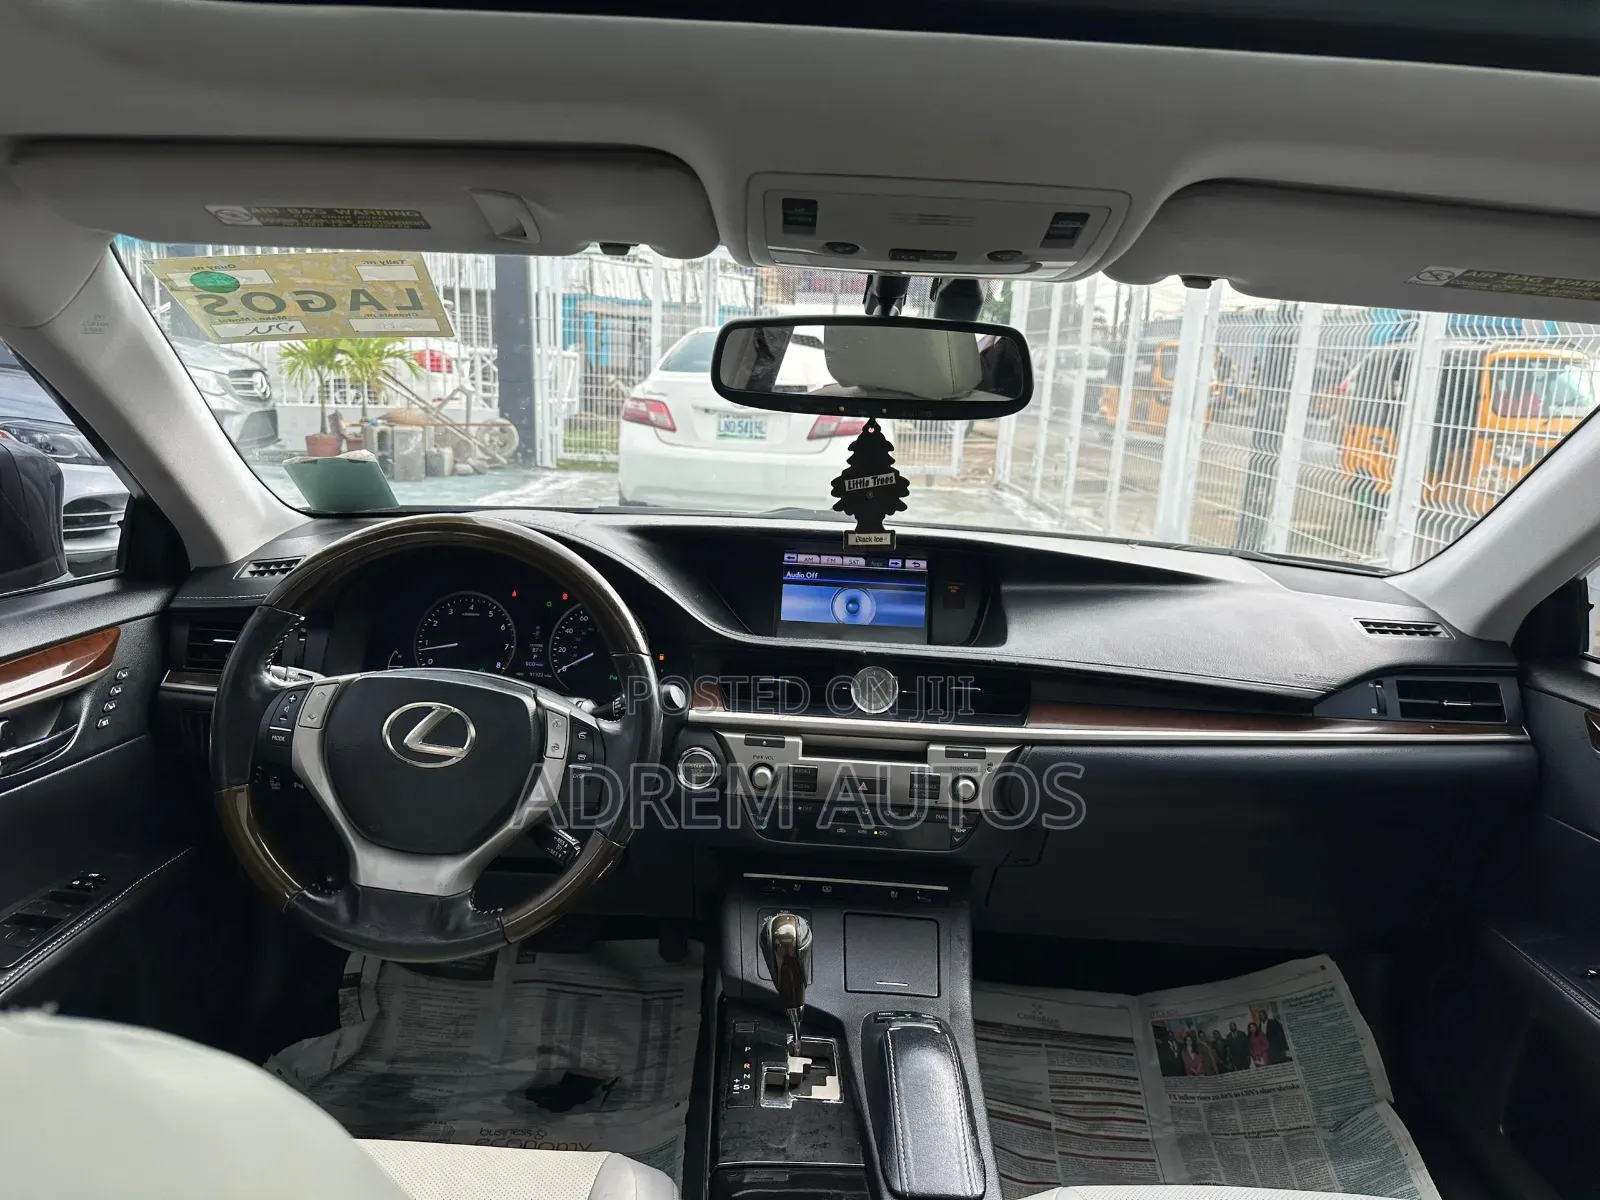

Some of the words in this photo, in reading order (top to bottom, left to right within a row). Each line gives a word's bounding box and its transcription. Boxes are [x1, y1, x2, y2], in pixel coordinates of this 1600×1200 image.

[287, 208, 326, 216] BAG
[335, 209, 420, 217] WARNING
[1463, 270, 1495, 279] AIR
[1503, 274, 1545, 283] BAG
[847, 478, 870, 490] Little
[871, 475, 894, 486] Trees
[806, 571, 818, 579] Off
[1260, 1087, 1276, 1095] share
[1277, 1084, 1300, 1092] shrinks
[480, 1126, 532, 1137] business
[534, 1128, 548, 1140] &
